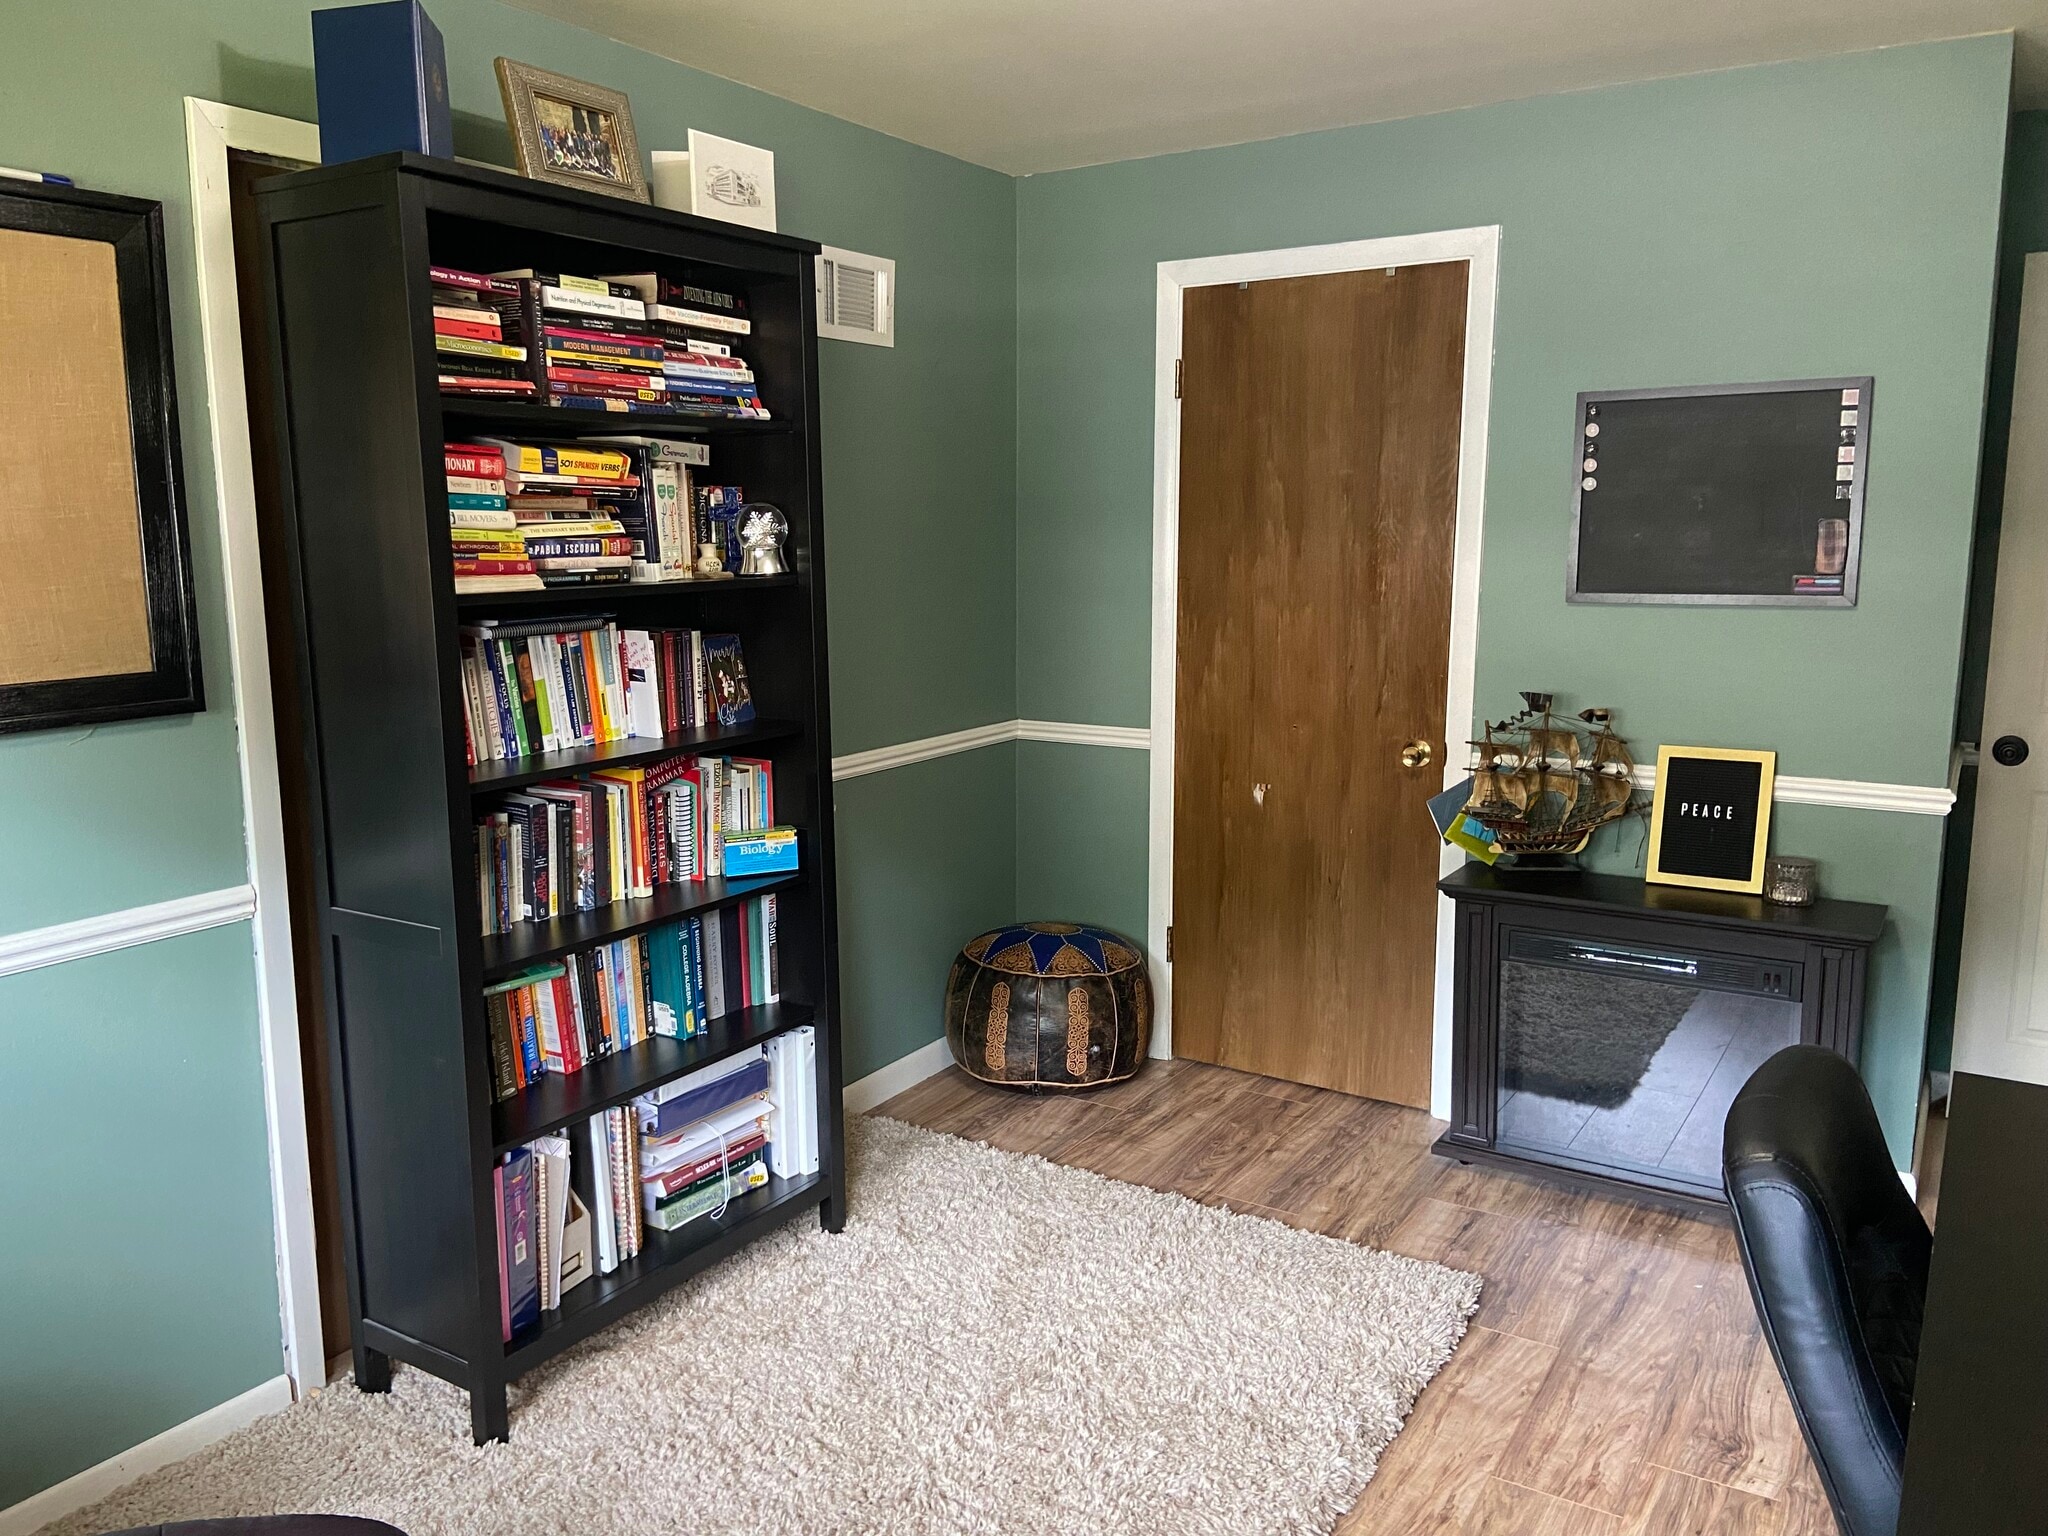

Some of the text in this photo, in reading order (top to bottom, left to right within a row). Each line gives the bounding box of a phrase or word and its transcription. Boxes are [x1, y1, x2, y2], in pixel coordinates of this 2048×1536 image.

[430, 270, 448, 279] ology
[458, 276, 481, 284] Action
[551, 294, 568, 303] Nutrition
[577, 298, 591, 306] Physical
[446, 339, 492, 353] Macroeconomics
[563, 341, 631, 355] MODERN MANAGEMENT
[701, 395, 723, 404] Manual
[662, 445, 689, 458] German
[446, 458, 475, 471] TIONARY
[560, 460, 620, 472] 501 SPANISH VERBS
[669, 502, 678, 544] Spanish
[699, 492, 707, 543] DICTIONA
[535, 543, 600, 555] PABLO ESCOBAR
[709, 643, 735, 663] Merry
[500, 682, 509, 708] FOCUS
[511, 686, 521, 708] Vaccine
[558, 694, 567, 713] boy
[697, 690, 702, 699] Pi
[485, 696, 500, 738] BITCHES
[645, 754, 685, 778] OMPUTER
[646, 766, 685, 791] RAMMAR
[1680, 802, 1734, 820] PEACE
[532, 818, 541, 842] KING
[539, 806, 548, 851] STEPHEN
[658, 808, 666, 868] SPELLER
[649, 811, 658, 879] DICTIONARY
[740, 844, 784, 855] Biology
[768, 898, 777, 946] WAR SOUL
[522, 986, 533, 1018] DICTABLY
[525, 1016, 536, 1062] IRRATIONAL
